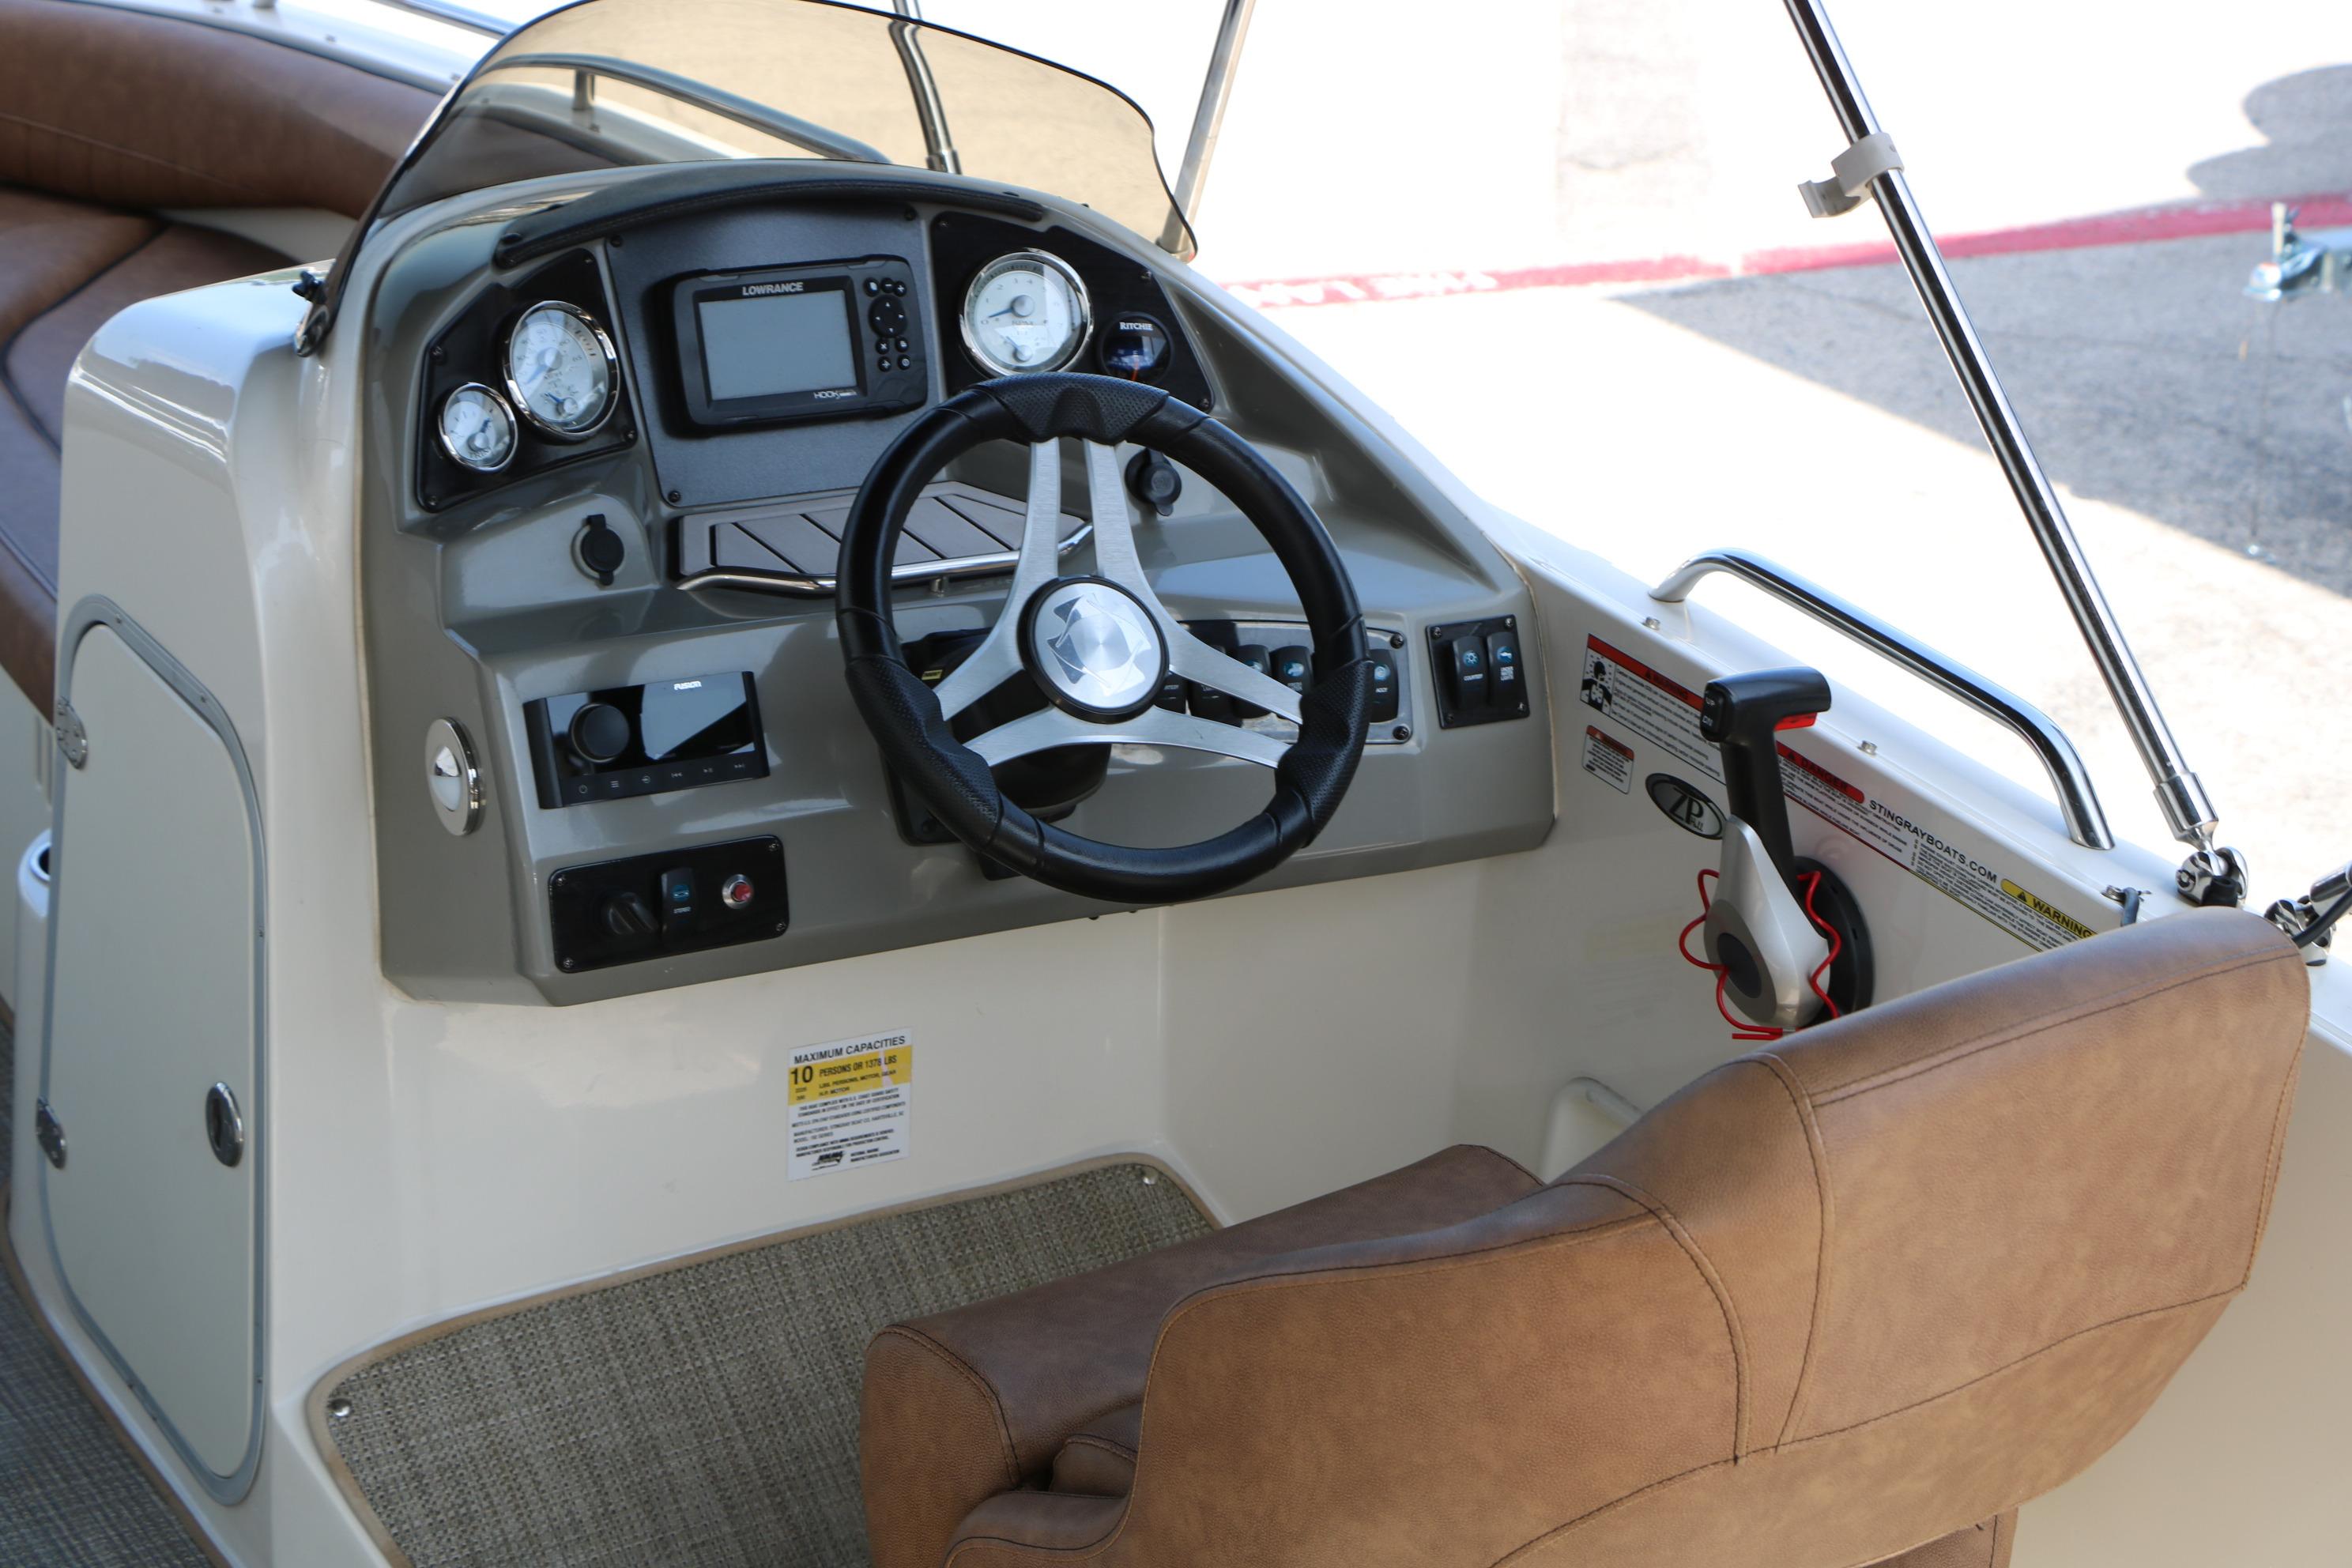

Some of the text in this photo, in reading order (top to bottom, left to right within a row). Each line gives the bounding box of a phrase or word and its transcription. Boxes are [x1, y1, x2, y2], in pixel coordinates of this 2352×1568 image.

[742, 281, 804, 296] LOWRANCE
[1119, 322, 1153, 330] RITCHIE
[1802, 758, 1847, 790] DANGER
[1869, 800, 1997, 884] STINGRAYBOATS.COM
[2033, 898, 2093, 937] WARNING
[794, 1035, 906, 1064] MAXIMUM CAPACITIES
[790, 1065, 813, 1085] 10
[819, 1062, 851, 1077] PERSONS
[853, 1061, 864, 1072] OR
[884, 1055, 897, 1065] LBS
